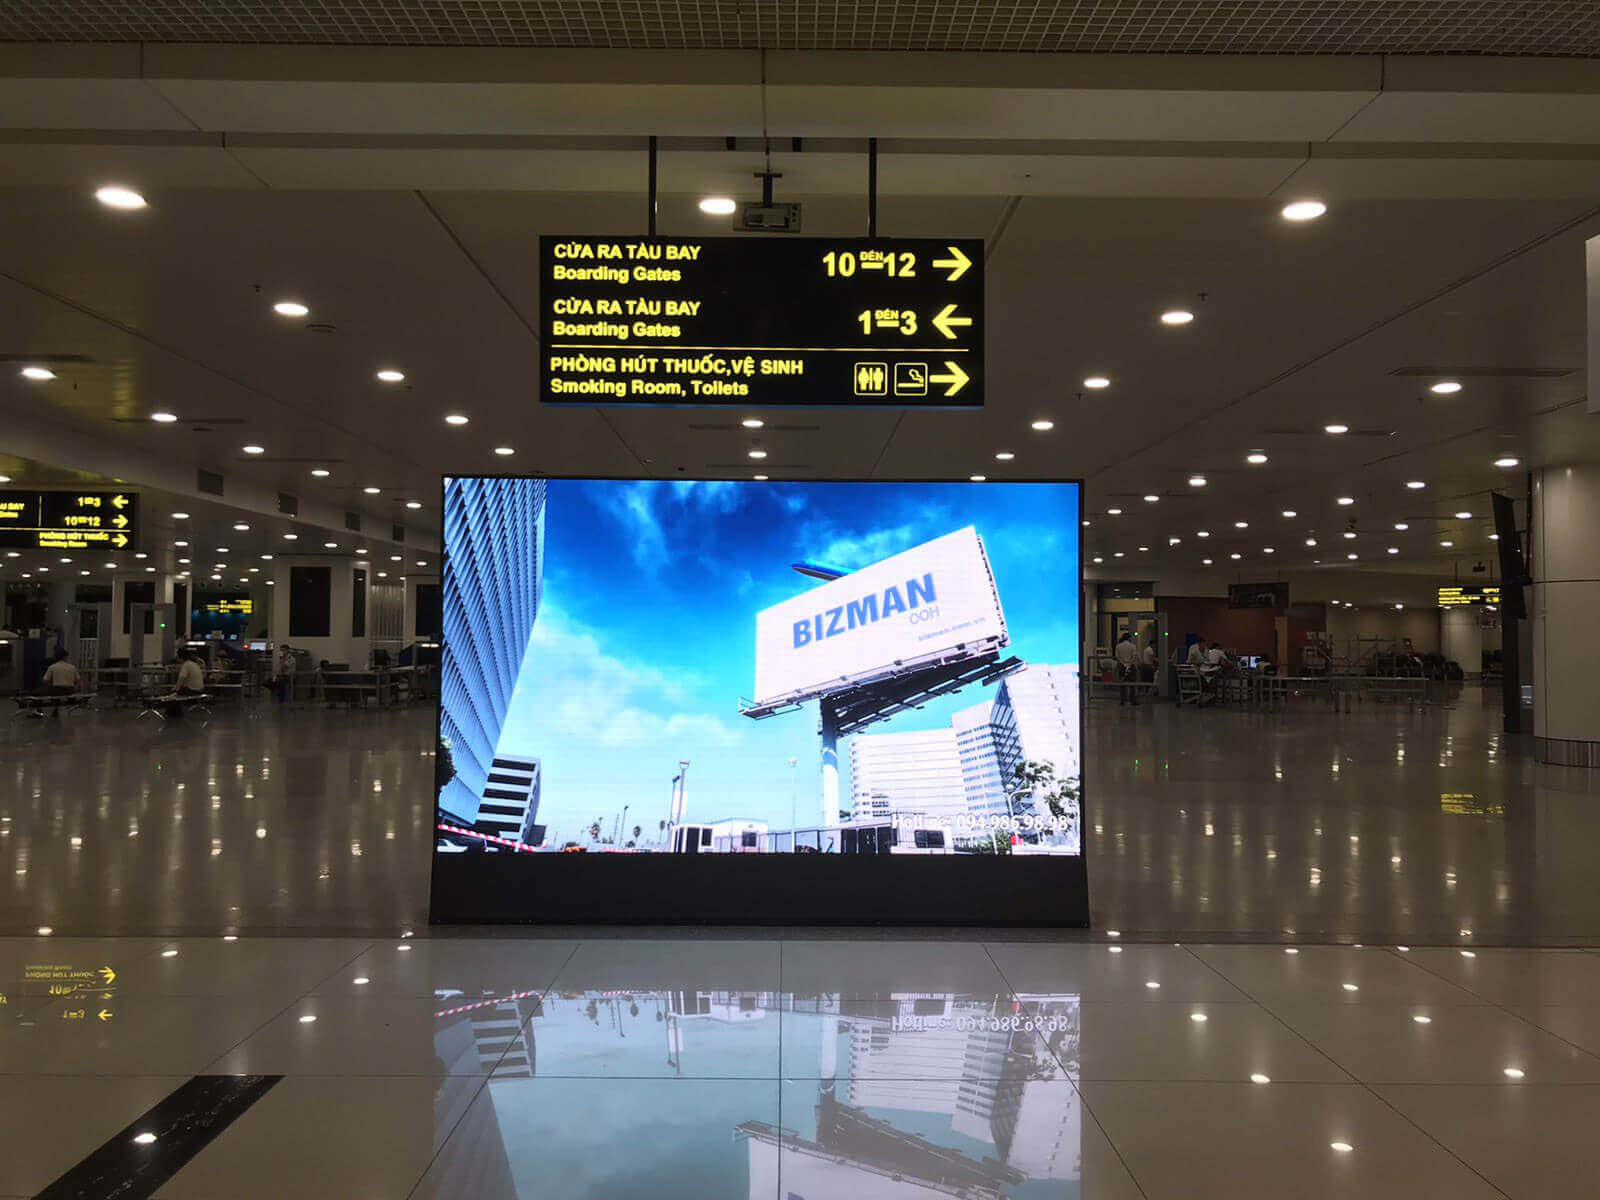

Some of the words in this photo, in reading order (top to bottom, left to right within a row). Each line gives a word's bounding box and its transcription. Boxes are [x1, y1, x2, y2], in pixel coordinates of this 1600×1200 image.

[554, 241, 594, 259] CỬA
[597, 243, 623, 259] RA
[626, 242, 662, 260] TÀU
[666, 245, 702, 260] BAY
[553, 264, 630, 285] Boarding
[633, 265, 682, 282] Gates
[822, 251, 856, 277] 10
[883, 252, 916, 277] 12
[553, 296, 593, 315] CỬA
[597, 298, 623, 315] RA
[625, 297, 662, 315] TÀU
[665, 300, 702, 316] BAY
[553, 320, 629, 341] Boarding
[633, 322, 682, 338] Gates
[858, 310, 872, 335] 1
[900, 310, 918, 336] 3
[550, 353, 617, 373] PHÒNG
[620, 354, 659, 374] HÚT
[760, 359, 804, 375] SINH
[550, 378, 627, 397] Smoking
[631, 380, 687, 397] Room,
[691, 380, 749, 396] Toilets
[792, 572, 938, 649] BIZMAN
